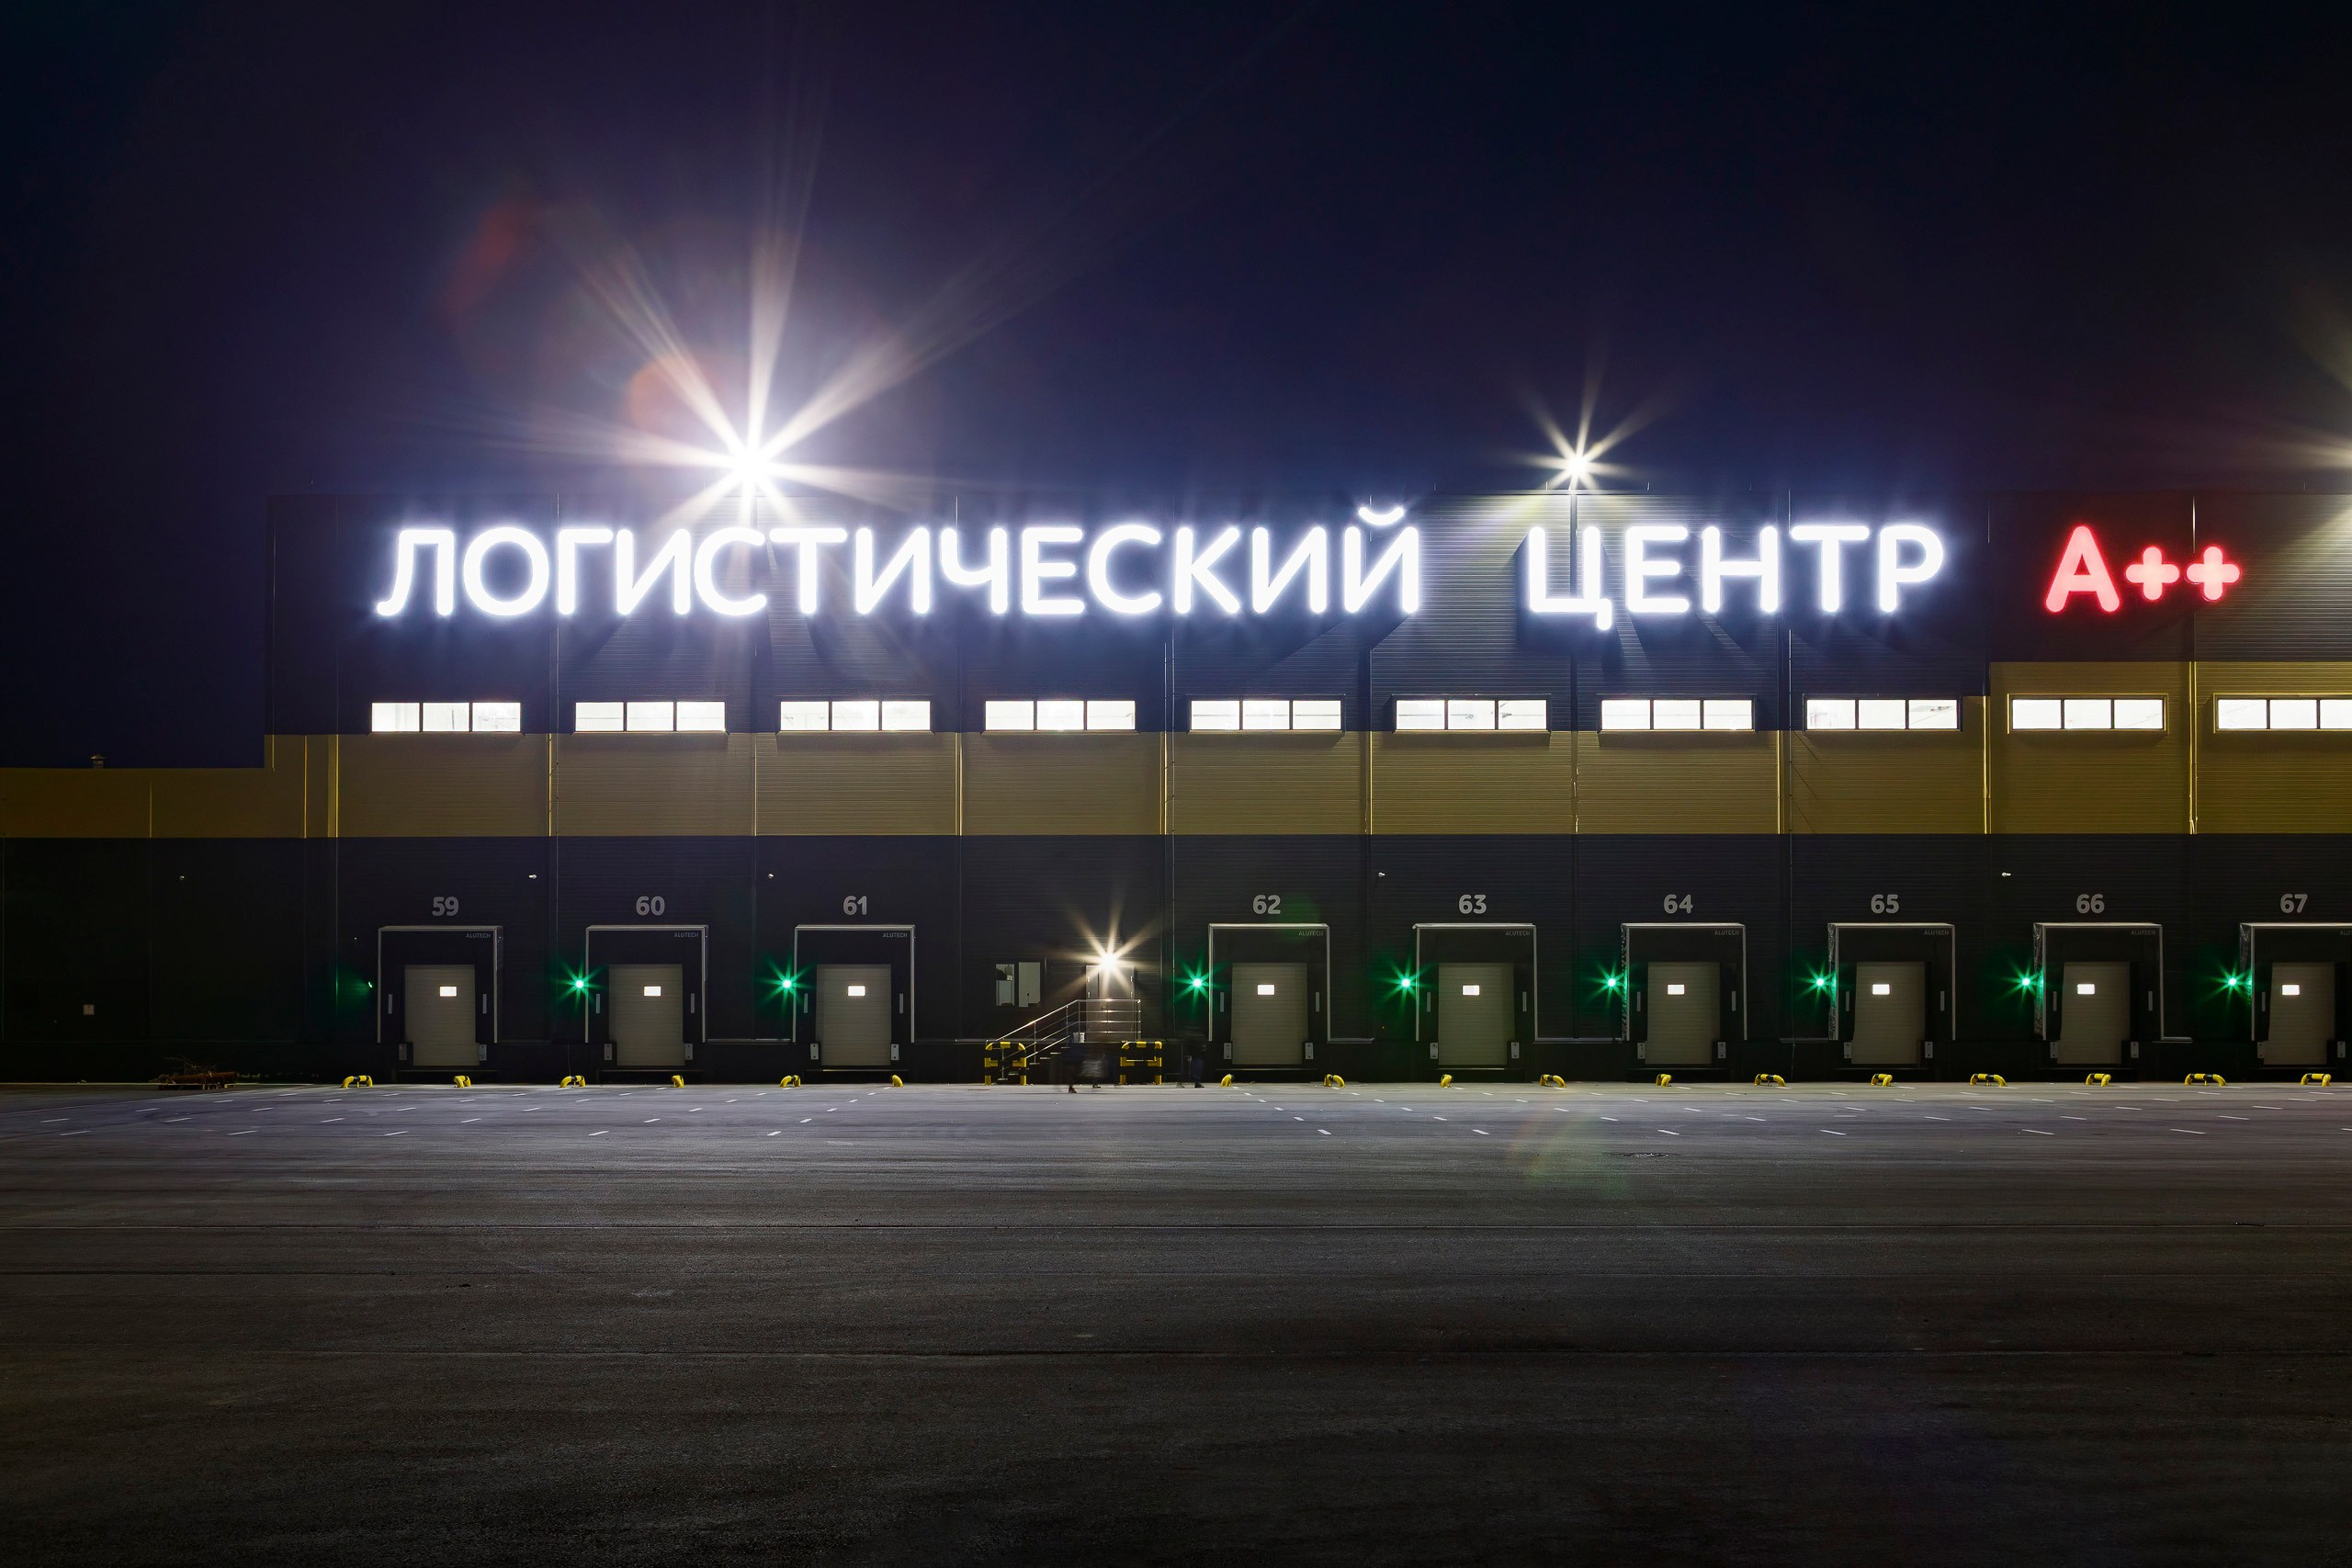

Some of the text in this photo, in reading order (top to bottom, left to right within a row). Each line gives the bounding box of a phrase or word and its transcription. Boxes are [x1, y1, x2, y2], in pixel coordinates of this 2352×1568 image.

[375, 505, 1420, 617] ЛОГИСТИЧЕСКИЙ
[1527, 524, 1945, 631] ЦЕНТР
[432, 896, 459, 917] 59
[636, 896, 665, 916] 60
[842, 895, 867, 916] 61
[1252, 895, 1282, 915] 62
[1458, 894, 1487, 914] 63
[1663, 894, 1694, 914] 64
[1871, 894, 1900, 914] 65
[2075, 893, 2105, 914] 66
[2279, 893, 2308, 914] 67
